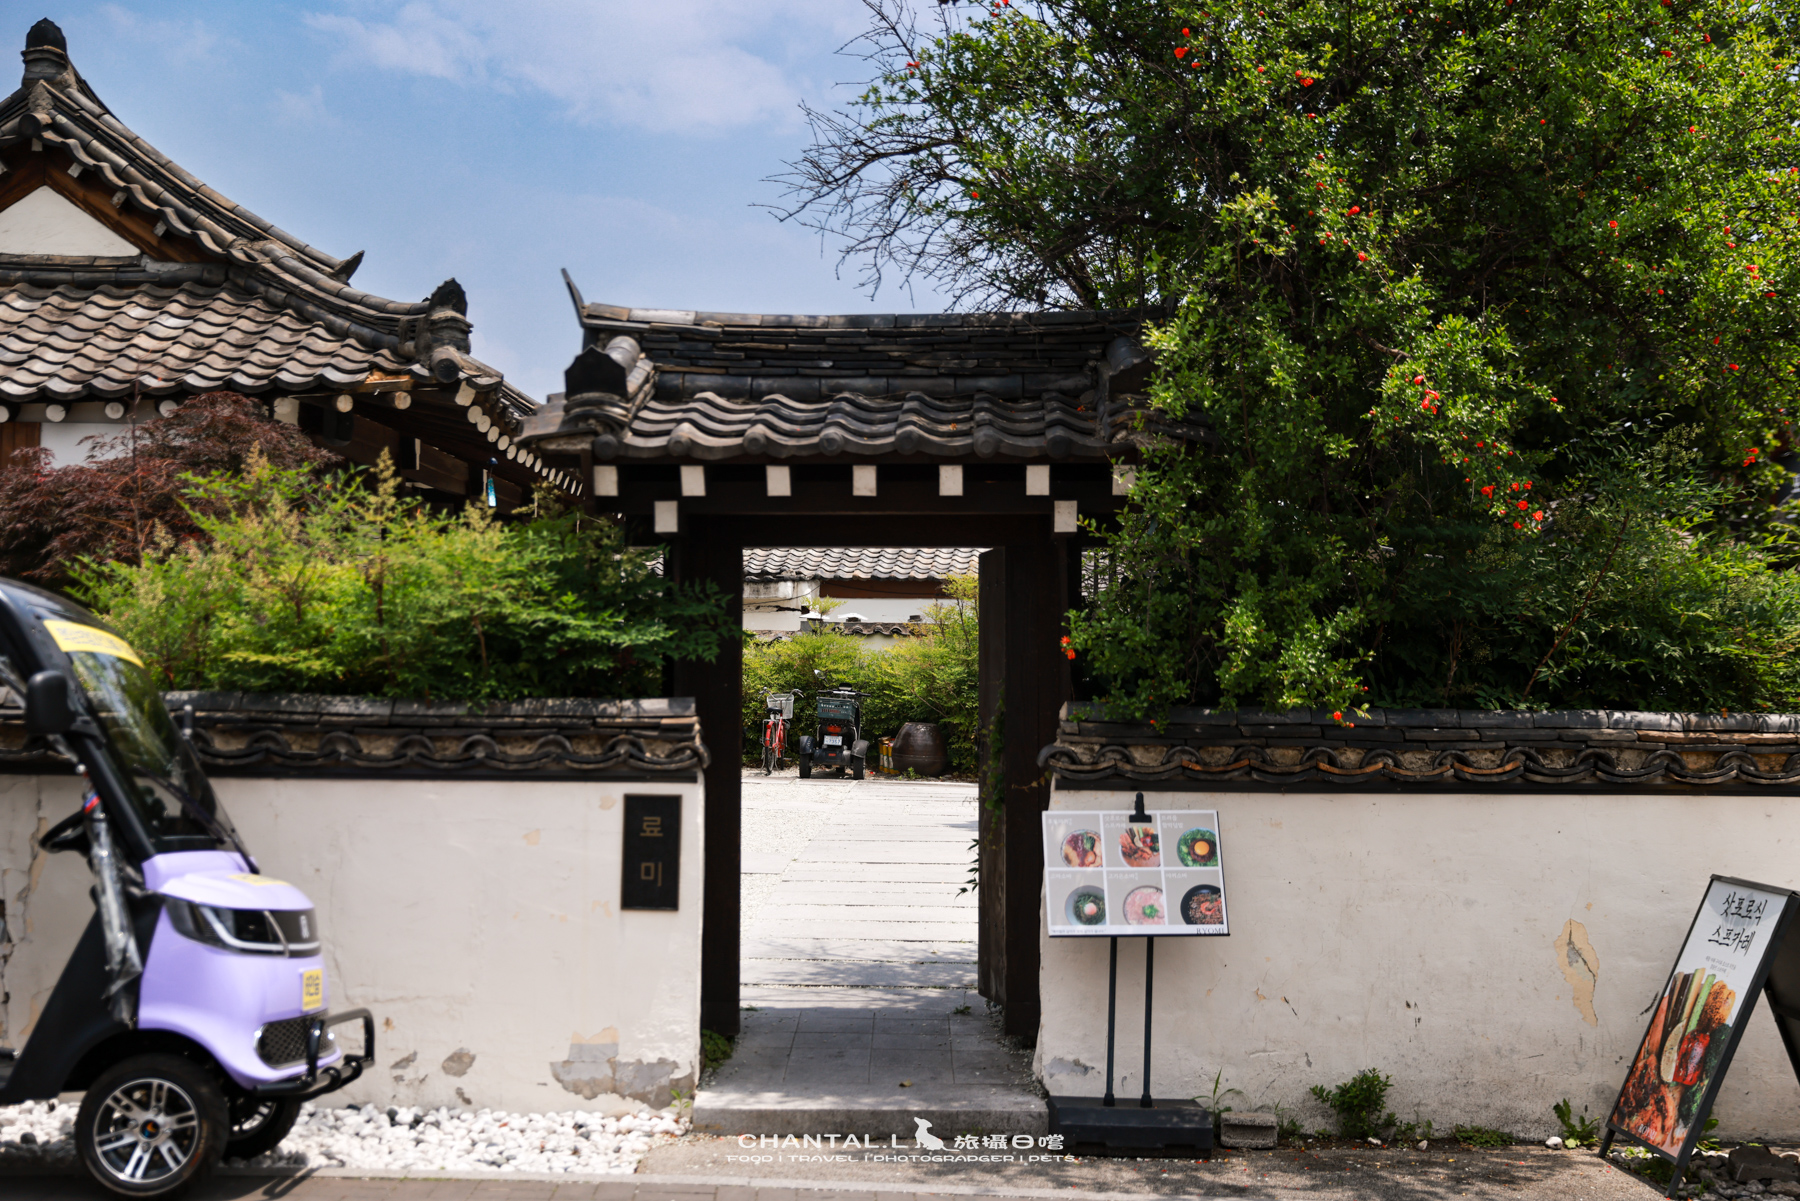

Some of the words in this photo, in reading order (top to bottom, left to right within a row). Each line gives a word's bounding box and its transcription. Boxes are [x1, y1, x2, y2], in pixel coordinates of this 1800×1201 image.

[640, 816, 663, 887] 료미
[1720, 892, 1767, 926] 삿포로식
[1196, 927, 1224, 935] RYOMI
[1708, 925, 1755, 956] 스프카레
